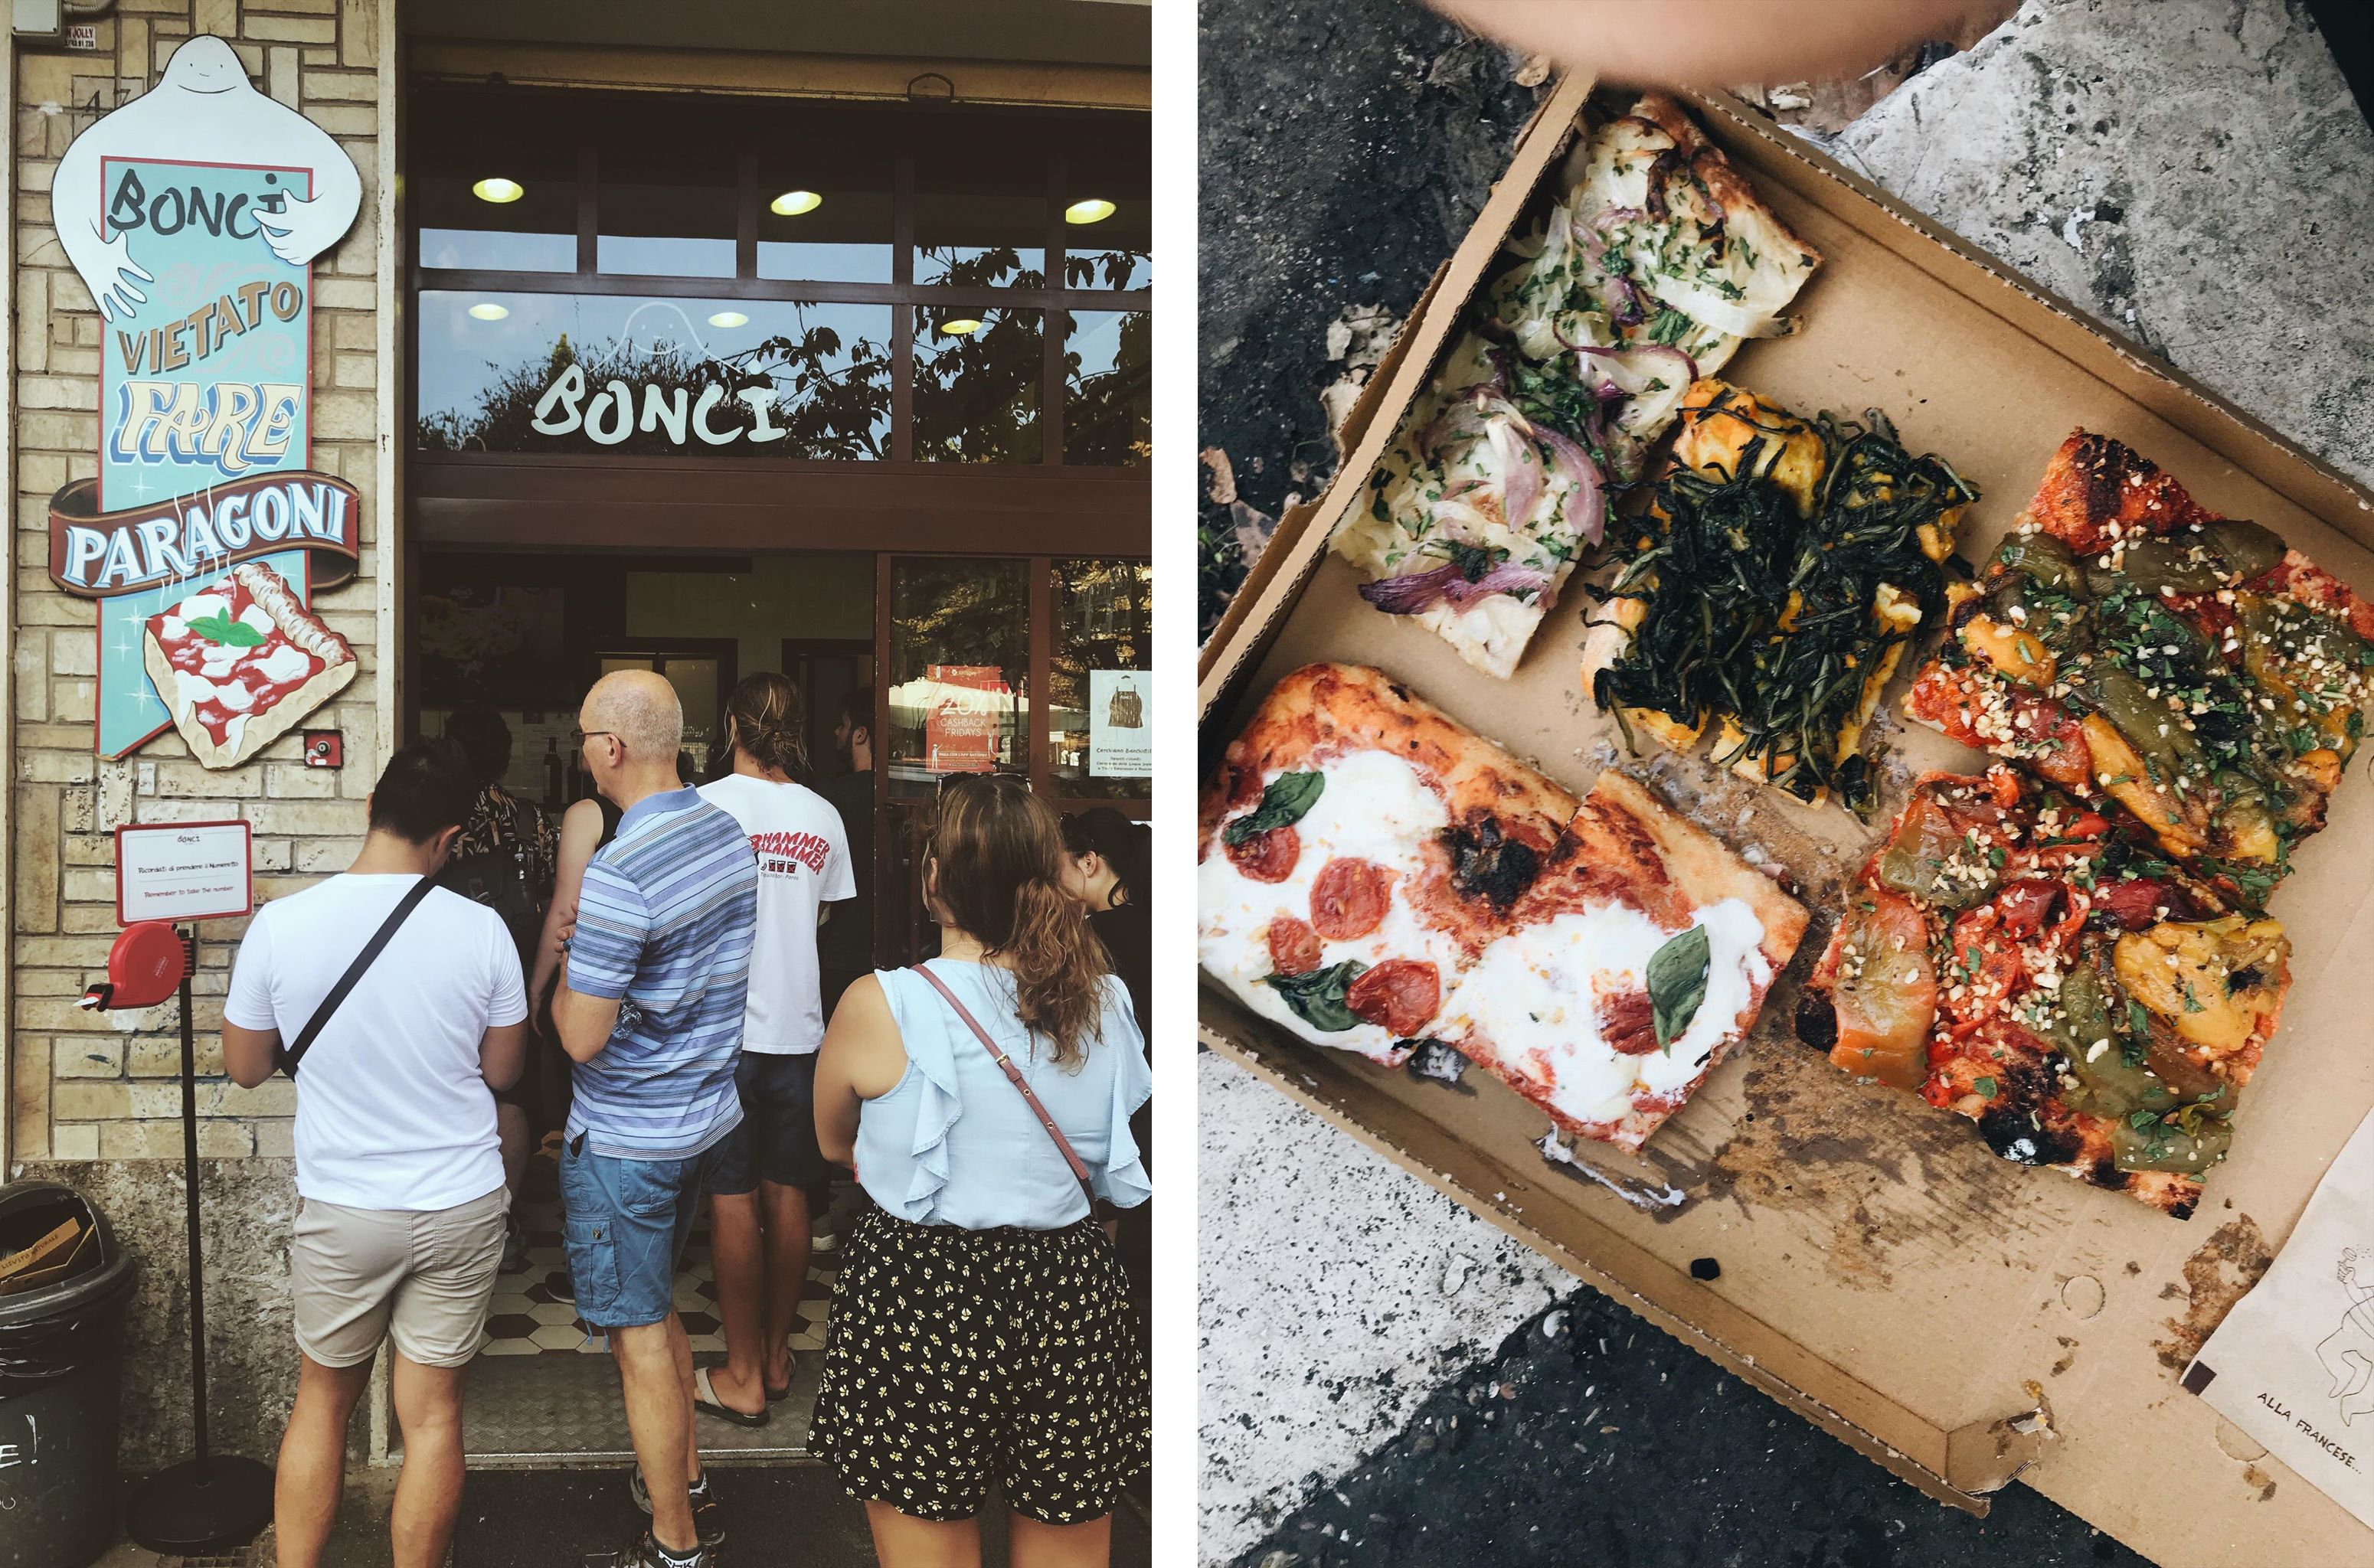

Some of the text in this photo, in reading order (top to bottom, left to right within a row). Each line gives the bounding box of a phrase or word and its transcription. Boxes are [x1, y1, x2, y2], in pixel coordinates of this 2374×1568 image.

[72, 27, 93, 38] JOLLY
[117, 281, 302, 376] VIETATO
[531, 364, 787, 446] BONCI
[110, 381, 304, 478] FARE
[62, 482, 349, 588] PARAGONI
[940, 690, 987, 717] 20%
[940, 717, 986, 727] CASHBACK
[945, 728, 982, 737] FRIDAYS
[177, 835, 201, 843] BONCI
[763, 831, 830, 860] HAMMER
[175, 863, 203, 872] prendere
[209, 861, 239, 869] Numeretto
[760, 842, 825, 876] SLAMMER
[144, 890, 177, 899] Remember
[2257, 1393, 2362, 1475] ALLA FRANCESE...
